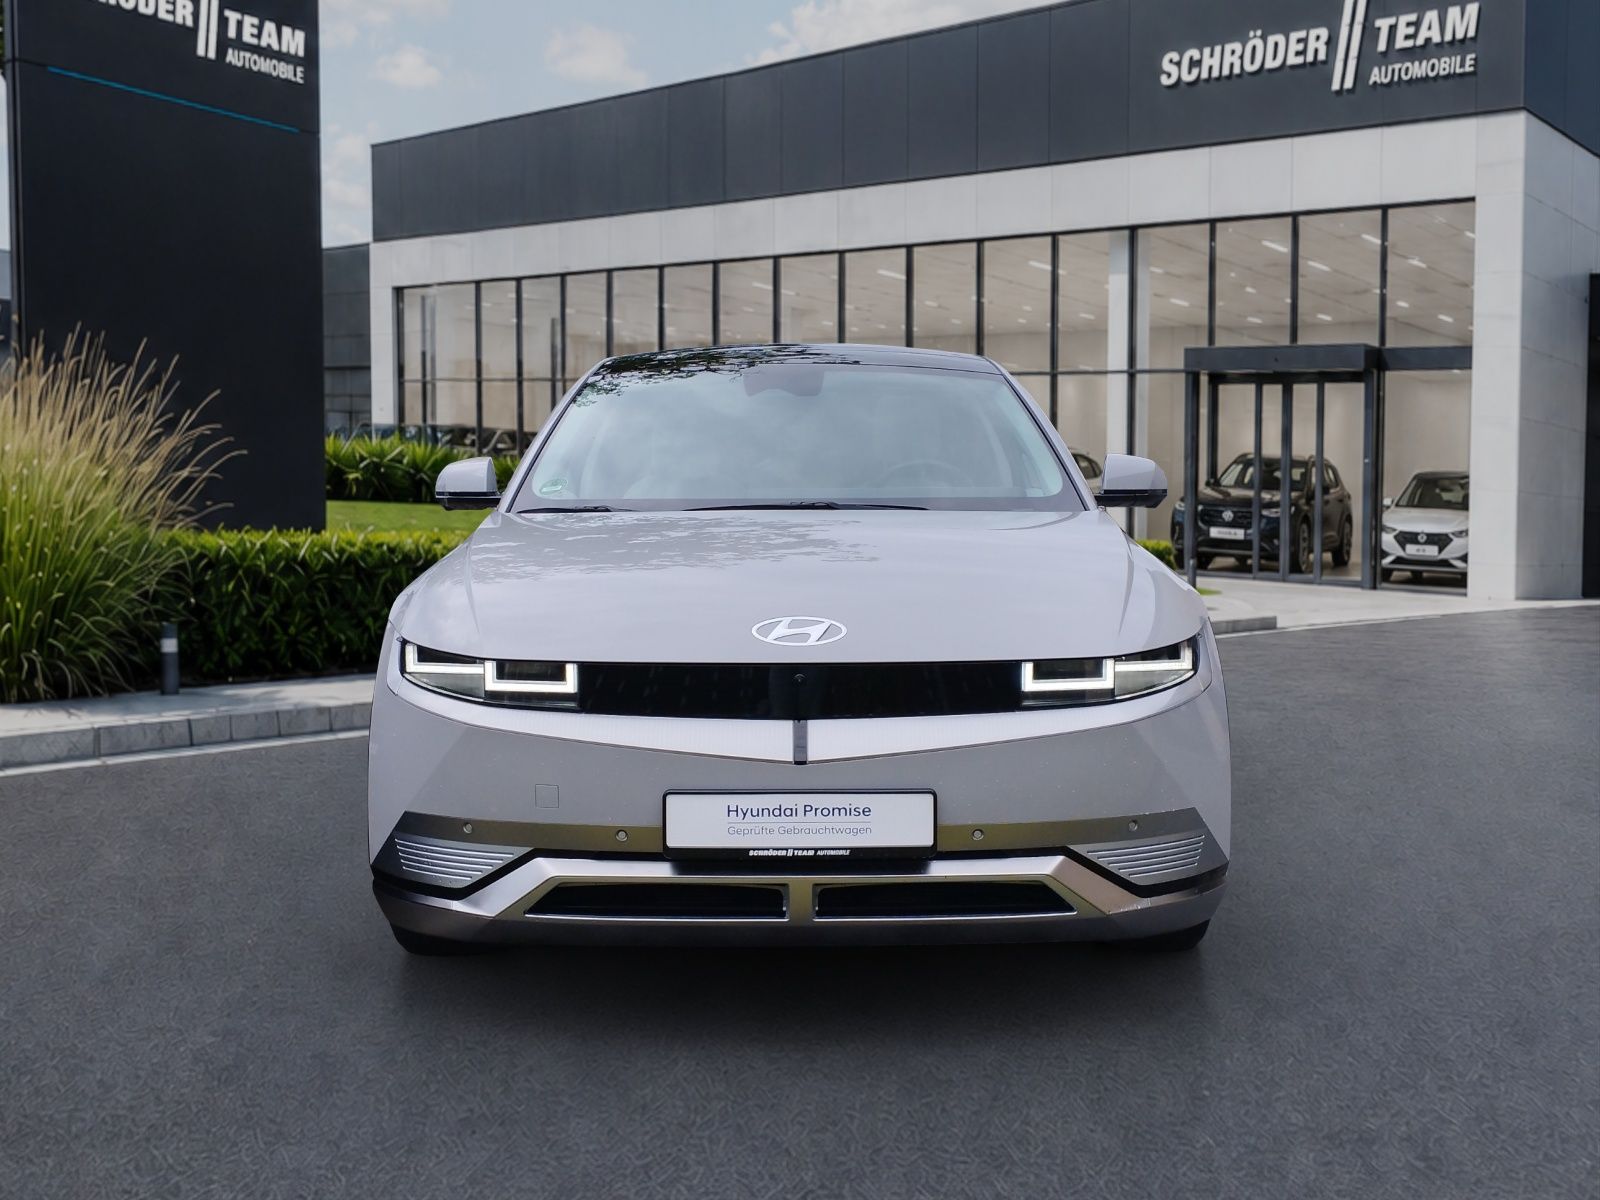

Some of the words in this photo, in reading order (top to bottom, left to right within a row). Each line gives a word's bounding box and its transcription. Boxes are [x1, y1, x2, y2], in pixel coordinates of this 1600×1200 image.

[224, 9, 306, 57] TEAM
[1159, 28, 1329, 86] SCHRÖDER
[1374, 2, 1480, 53] TEAM
[226, 47, 305, 84] AUTOMOBILE
[1368, 53, 1476, 86] AUTOMOBILE
[727, 803, 798, 819] Hyundai
[803, 803, 872, 817] Promise
[727, 825, 775, 836] Geprüfte
[777, 825, 872, 837] Gebrauchtwagen
